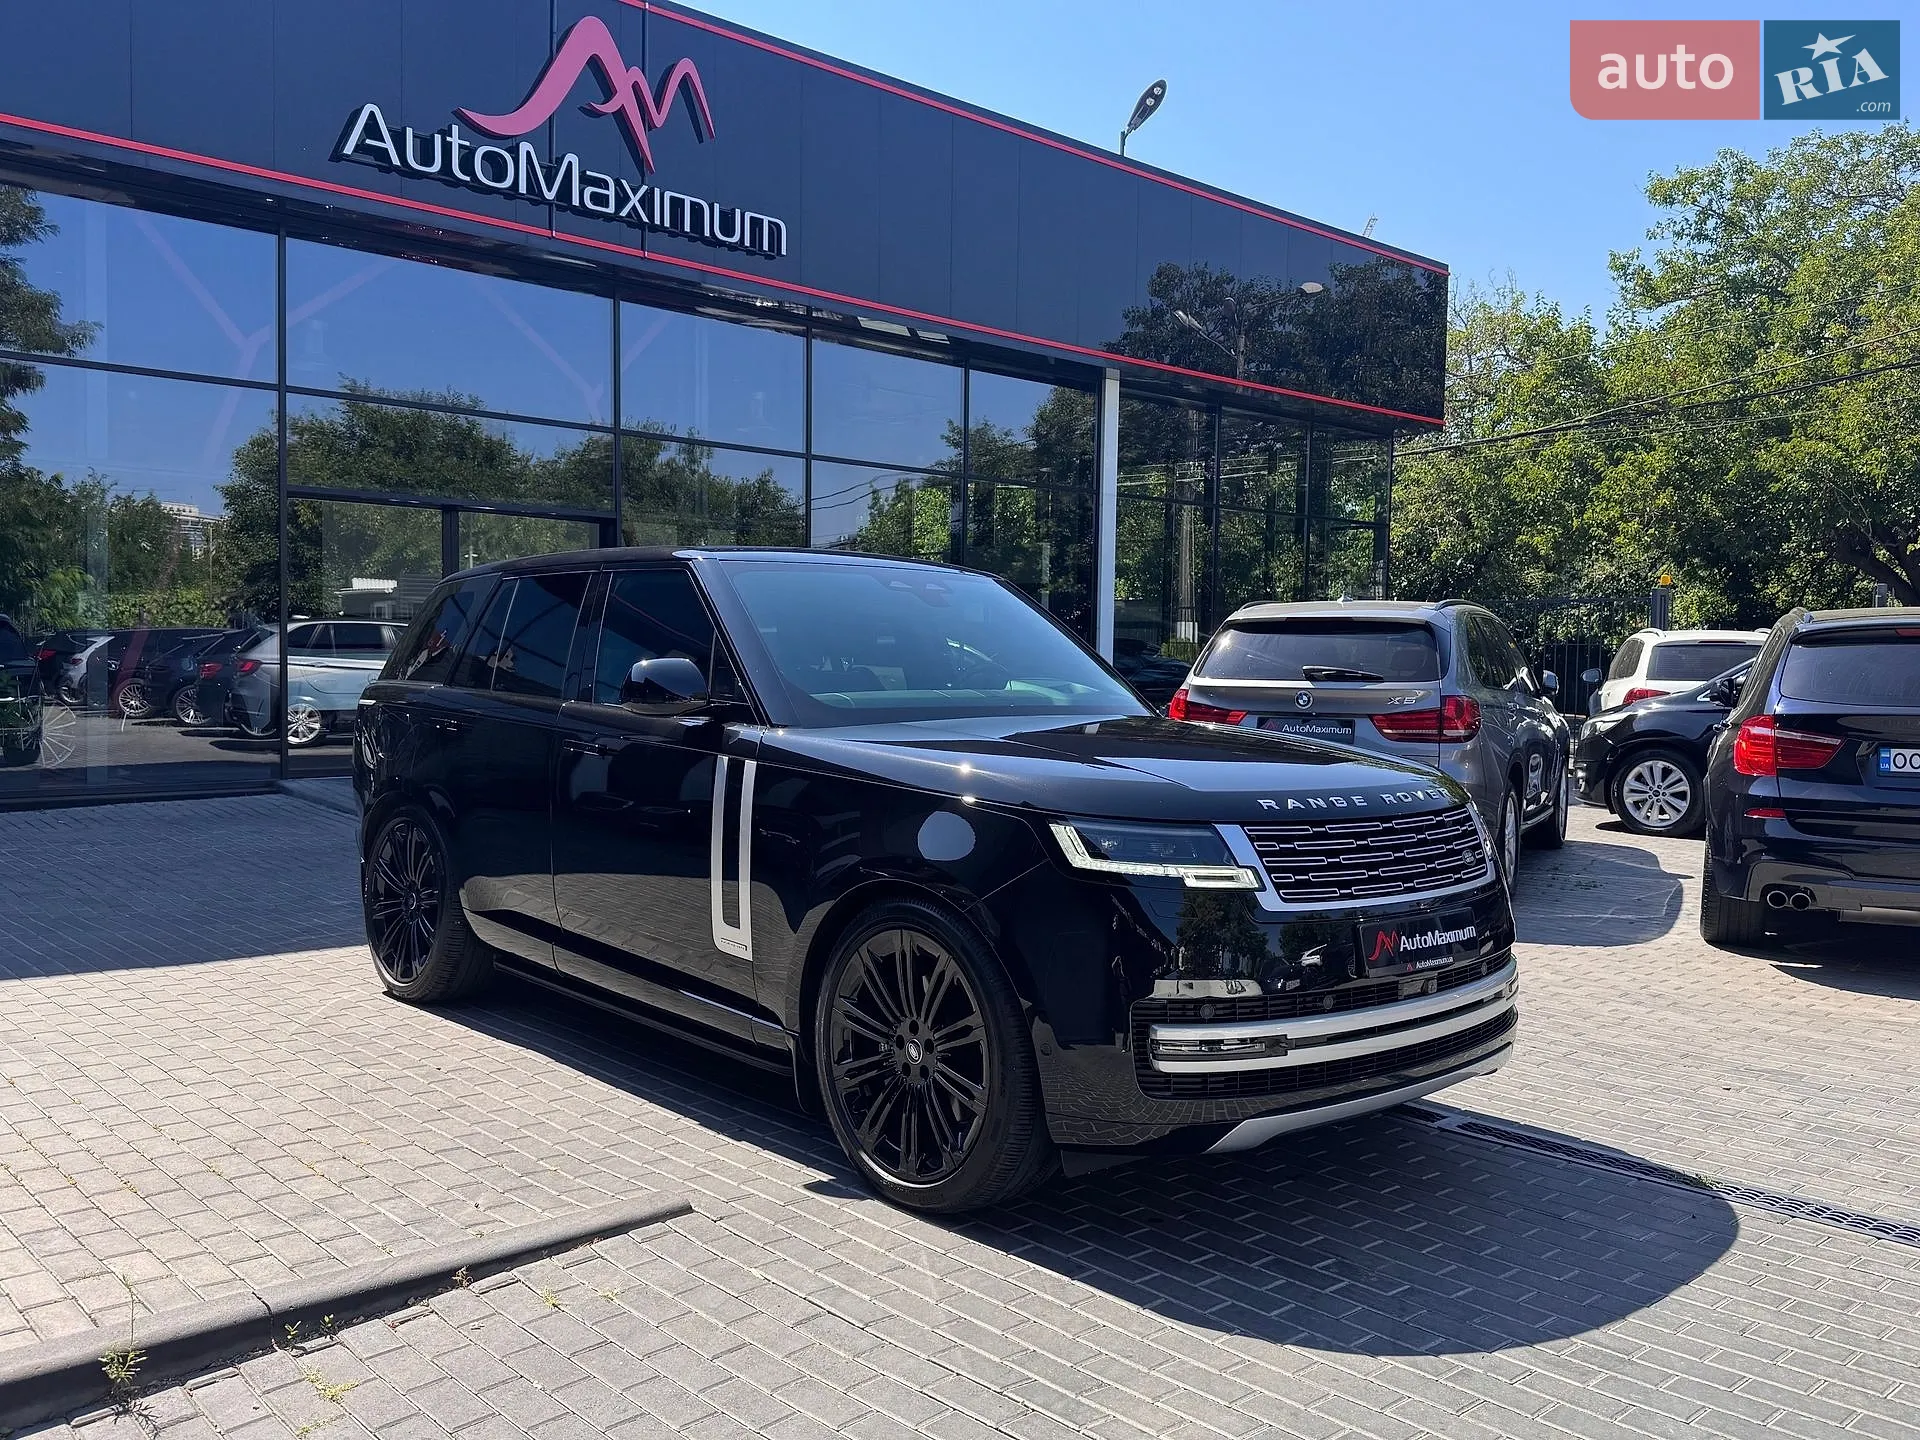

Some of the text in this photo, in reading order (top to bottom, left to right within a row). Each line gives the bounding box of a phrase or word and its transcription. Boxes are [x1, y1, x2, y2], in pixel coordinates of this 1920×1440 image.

[341, 103, 788, 257] AutoMaximum
[1387, 696, 1417, 706] X5
[1281, 723, 1353, 735] AutoMaximum
[1256, 787, 1452, 811] RANGE ROVER
[1400, 925, 1477, 952] AutoMaximum
